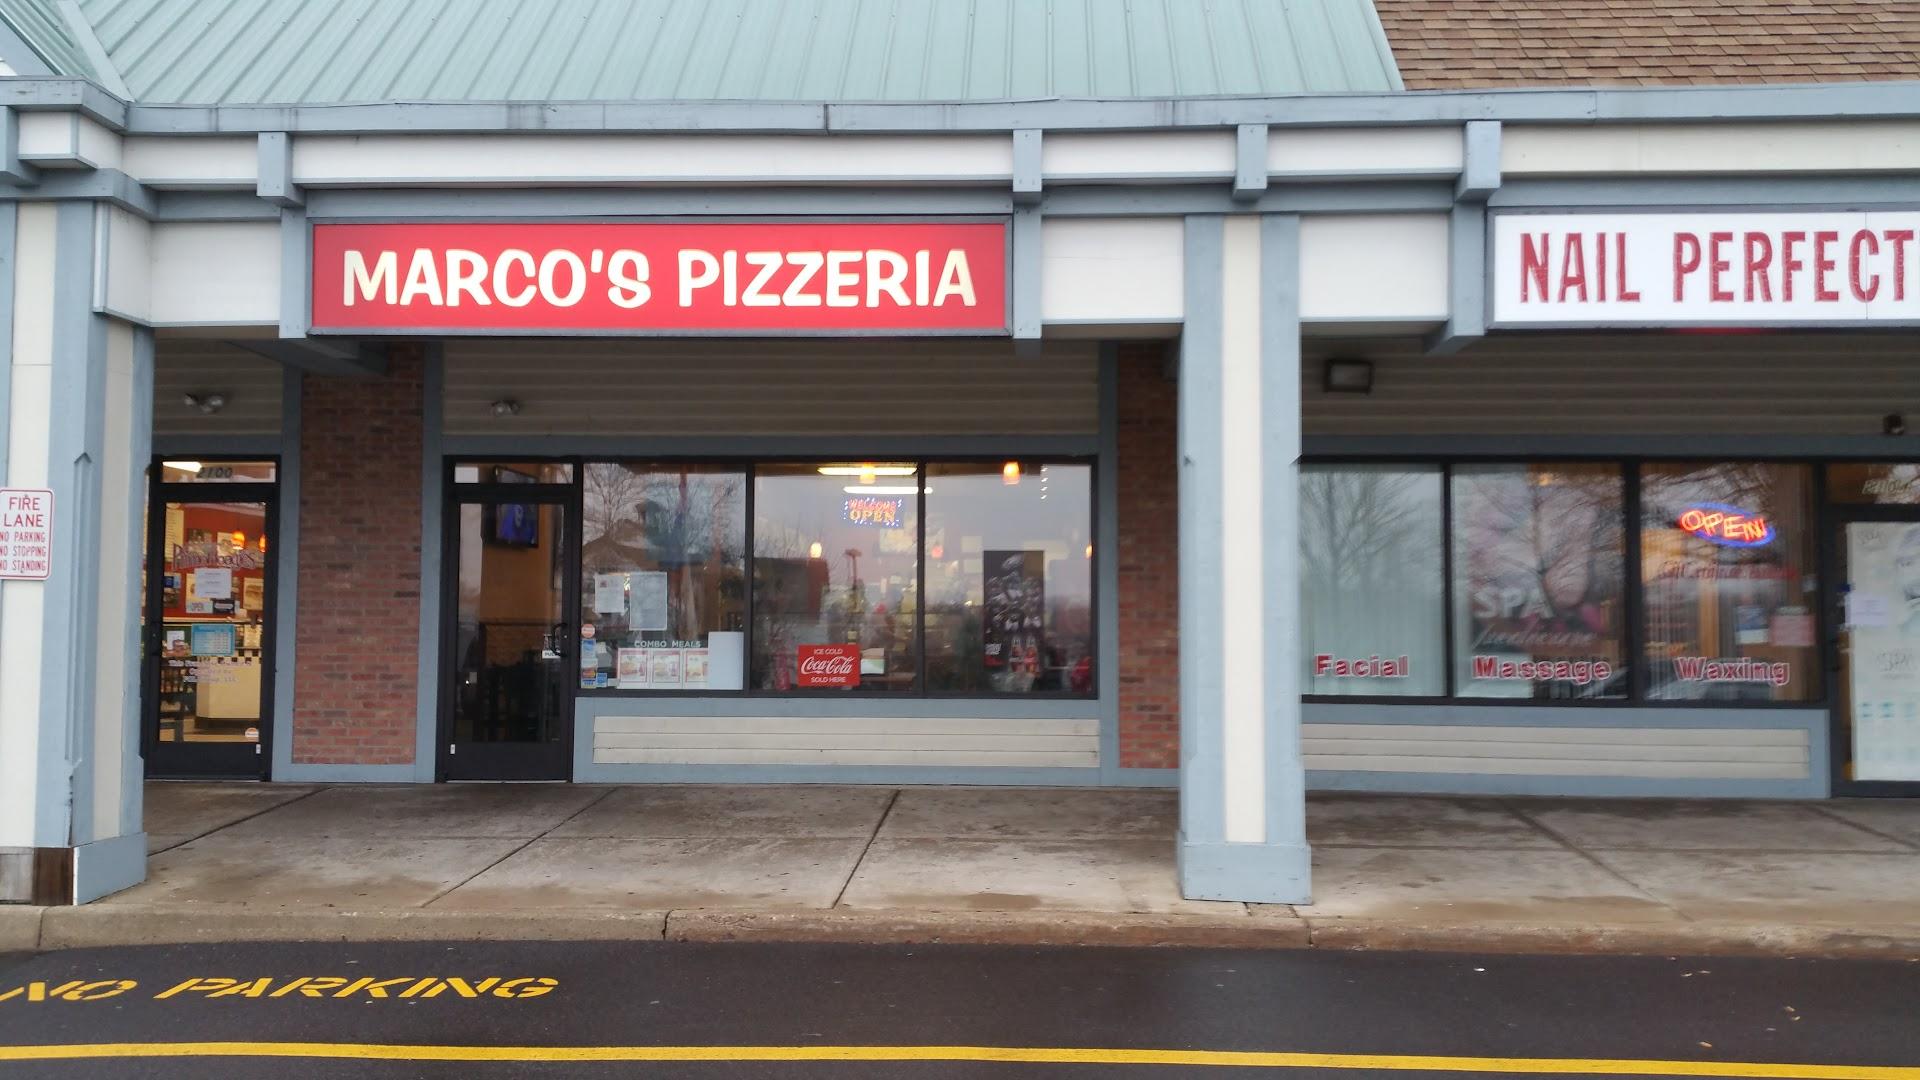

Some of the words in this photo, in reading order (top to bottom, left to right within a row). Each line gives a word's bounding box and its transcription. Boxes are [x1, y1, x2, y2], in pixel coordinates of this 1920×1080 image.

[1520, 232, 1641, 303] NAIL
[1672, 229, 1914, 303] PERFECT
[343, 248, 652, 309] MARCO'S
[678, 249, 977, 308] PIZZERIA
[9, 496, 41, 511] FIRE
[848, 499, 897, 513] WELCOME
[3, 513, 44, 528] LANE
[849, 510, 896, 523] OPEN
[1680, 510, 1768, 542] OPEN
[14, 531, 46, 543] PARKING
[13, 545, 46, 558] STOPPING
[12, 560, 46, 571] STANDING
[1474, 585, 1554, 619] SPA
[634, 640, 667, 648] COMBO
[671, 640, 701, 648] MEALS
[801, 656, 855, 674] Coca-Cola
[1313, 654, 1408, 677] Facial
[1472, 655, 1612, 685] Massage
[1673, 657, 1790, 686] Waxing
[0, 979, 138, 1001] NO
[152, 977, 559, 999] PARKING
